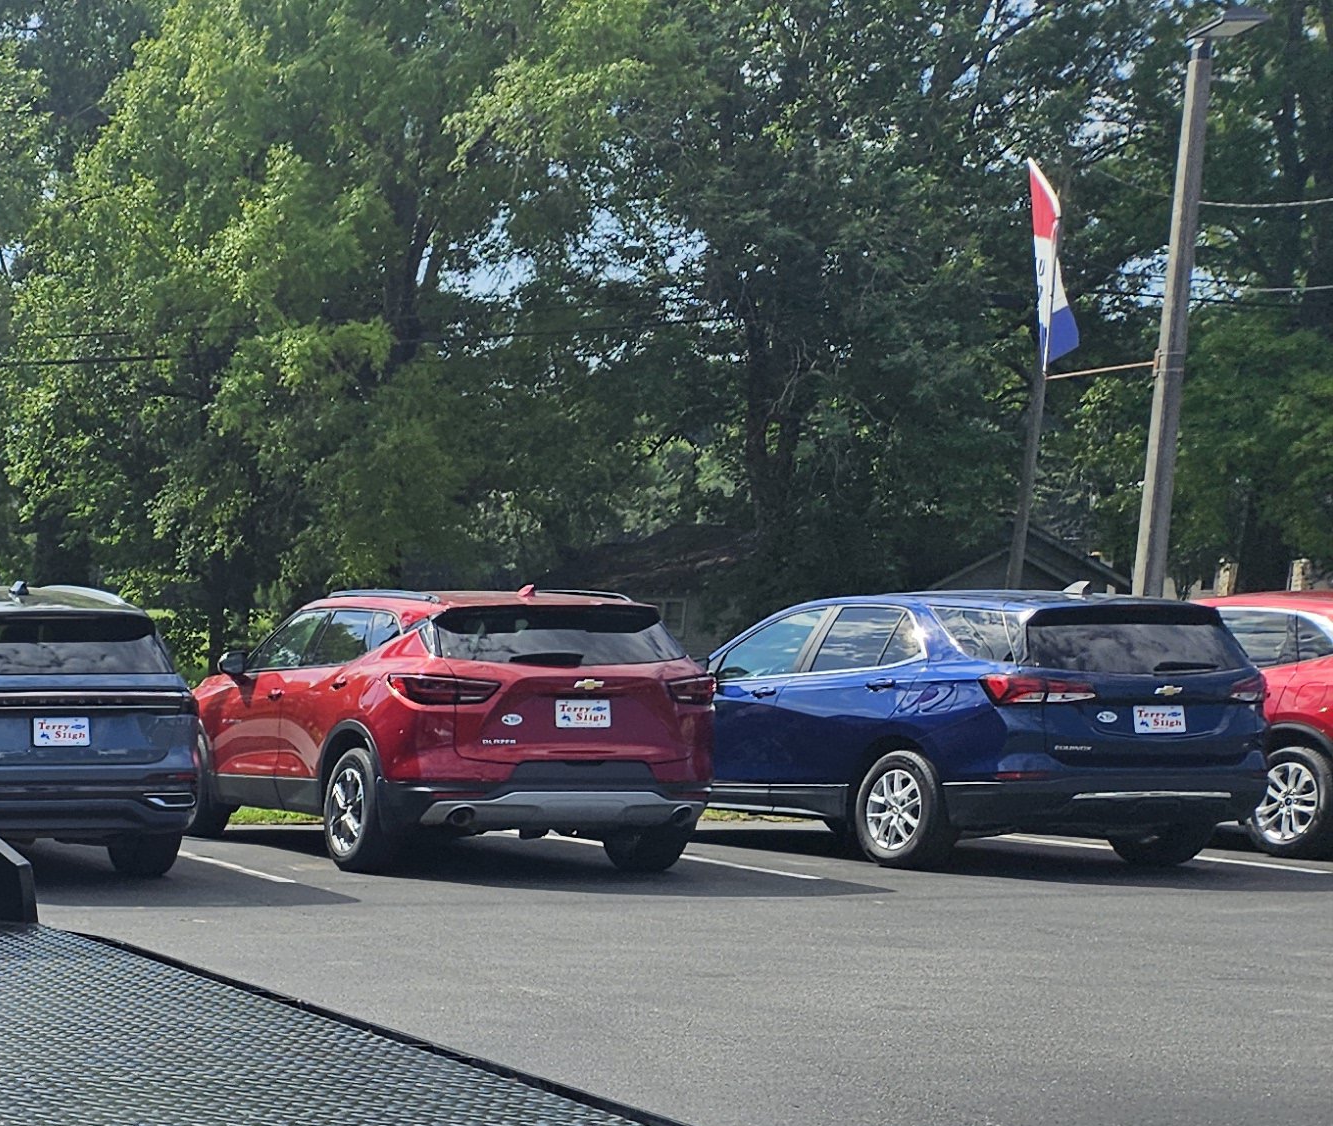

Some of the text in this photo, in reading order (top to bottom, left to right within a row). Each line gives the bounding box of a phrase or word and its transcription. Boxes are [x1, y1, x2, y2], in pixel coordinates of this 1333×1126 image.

[559, 704, 591, 713] Terry
[575, 712, 607, 722] Sligh
[1137, 709, 1167, 719] Terry
[38, 720, 71, 732] Terry
[1153, 718, 1182, 728] Sligh
[54, 730, 86, 741] Sligh
